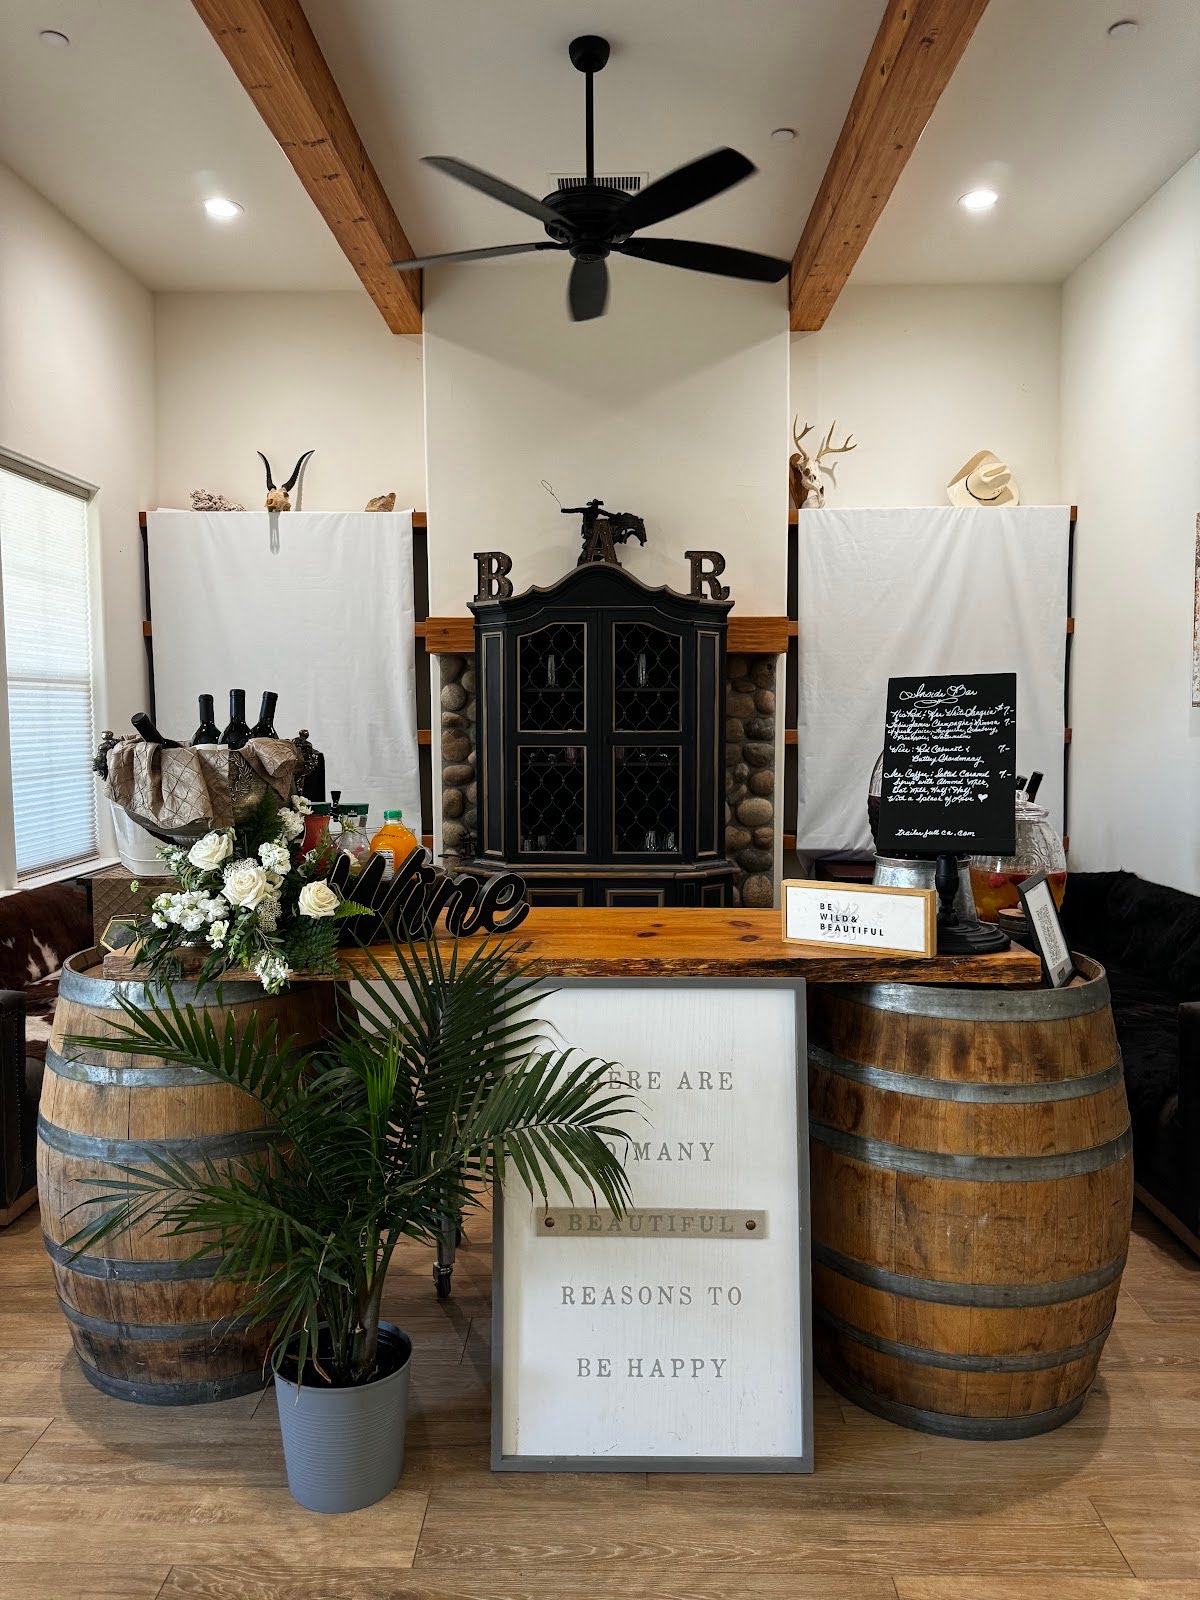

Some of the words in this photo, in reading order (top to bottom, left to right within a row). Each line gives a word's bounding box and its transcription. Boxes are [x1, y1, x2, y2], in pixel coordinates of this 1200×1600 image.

[900, 683, 946, 700] Inside
[946, 684, 978, 697] Bar
[906, 708, 922, 722] Red
[928, 708, 945, 721] Her
[945, 705, 966, 717] White
[965, 705, 997, 719] Sangria
[931, 719, 971, 730] Champagne
[916, 743, 930, 755] Red
[930, 745, 964, 753] Cabernet
[937, 753, 985, 768] Chardonnay
[884, 768, 904, 778] Ice
[934, 768, 958, 778] Salted
[958, 769, 991, 778] Caramel
[892, 778, 915, 787] Syrup
[930, 786, 948, 796] Half
[887, 794, 905, 802] With
[915, 793, 943, 803] Splash
[944, 795, 953, 807] of
[952, 794, 975, 803] Love
[329, 844, 530, 947] Wine
[820, 902, 832, 911] BE
[820, 923, 884, 937] BEAUTIFUL
[677, 1071, 733, 1090] ARE
[633, 1142, 715, 1161] MANY
[567, 1213, 734, 1233] BEAUTIFUL
[561, 1285, 692, 1305] REASONS
[708, 1286, 742, 1306] TO
[576, 1358, 612, 1377] BE
[627, 1358, 727, 1378] HAPPY
